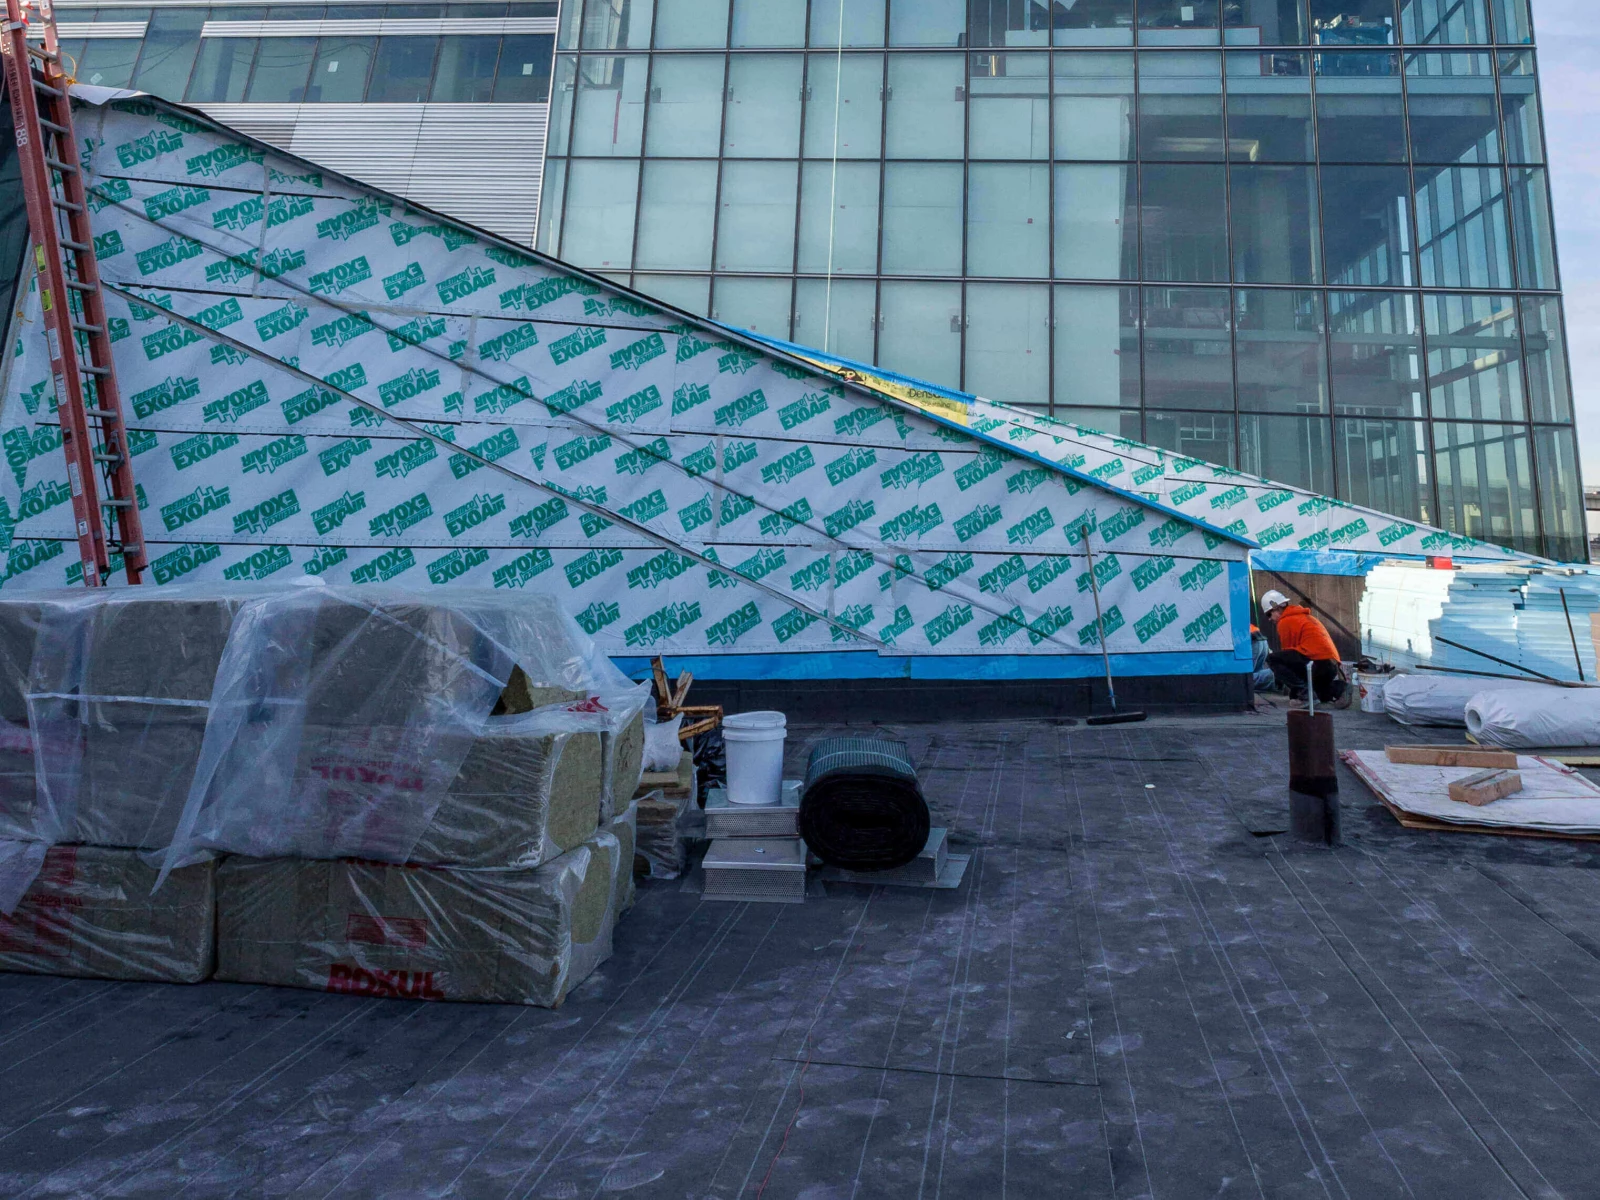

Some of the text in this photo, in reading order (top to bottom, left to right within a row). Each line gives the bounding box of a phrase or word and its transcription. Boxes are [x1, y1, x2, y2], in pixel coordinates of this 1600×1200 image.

[118, 139, 183, 169] EXOAIR
[212, 195, 264, 223] XOAIR
[267, 204, 314, 228] XOAIR
[316, 206, 378, 232] EXOAIR
[138, 243, 203, 276] EXOAIR
[259, 255, 306, 283] XOAIR
[309, 256, 370, 287] EXOAIR
[438, 273, 496, 305] EXOAIR
[479, 323, 536, 357] EXOAIR
[550, 334, 606, 365] EXOAIR
[610, 333, 664, 364] EXOAIR
[132, 382, 200, 420] EXOAIR
[203, 380, 268, 417] EXOAIR
[380, 374, 440, 408] EXOAIR
[606, 384, 661, 418] EXOAIR
[672, 388, 711, 416] XOAIR
[714, 389, 766, 421] EXOAIR
[780, 398, 831, 431] EXOAIR
[834, 407, 871, 433] XOAIR
[172, 435, 239, 471] EXOAIR
[241, 435, 306, 467] EXOAIR
[374, 439, 435, 471] EXOAIR
[554, 436, 612, 471] EXOAIR
[761, 445, 813, 479] EXOAIR
[827, 453, 877, 486] EXOAIR
[880, 454, 921, 485] XOAIR
[956, 459, 1002, 491] EXOAIR
[163, 494, 231, 532] EXOAIR
[233, 488, 298, 529] EXOAIR
[369, 493, 430, 532] EXOAIR
[445, 498, 506, 538] EXOAIR
[508, 497, 567, 532] EXOAIR
[825, 506, 875, 538] EXOAIR
[879, 505, 920, 536] XOAIR
[1007, 507, 1052, 539] EXOAIR
[955, 509, 1002, 542] EXOAIR
[1101, 513, 1145, 543] EXOAIR
[6, 545, 63, 579] XOAIR
[152, 545, 220, 585] EXOAIR
[224, 546, 290, 579] EXOAIR
[351, 548, 414, 582] EXOAIR
[428, 550, 489, 584] EXOAIR
[492, 548, 552, 582] EXOAIR
[567, 551, 623, 589] EXOAIR
[627, 550, 669, 584] XOAIR
[742, 554, 786, 581] XOAIR
[790, 555, 830, 585] XOAIR
[834, 557, 875, 589] XOAIR
[978, 555, 1026, 589] EXOAIR
[1028, 560, 1072, 594] EXOAIR
[1132, 560, 1175, 592] EXOAIR
[1179, 560, 1223, 586] EXOAIR
[624, 606, 667, 641] XOAIR
[662, 606, 702, 638] XOAIR
[706, 601, 759, 639] EXOAIR
[925, 611, 974, 646] EXOAIR
[1135, 609, 1178, 644] EXOAIR
[1182, 603, 1224, 639] EXOAIR
[327, 964, 444, 998] ROXUL
